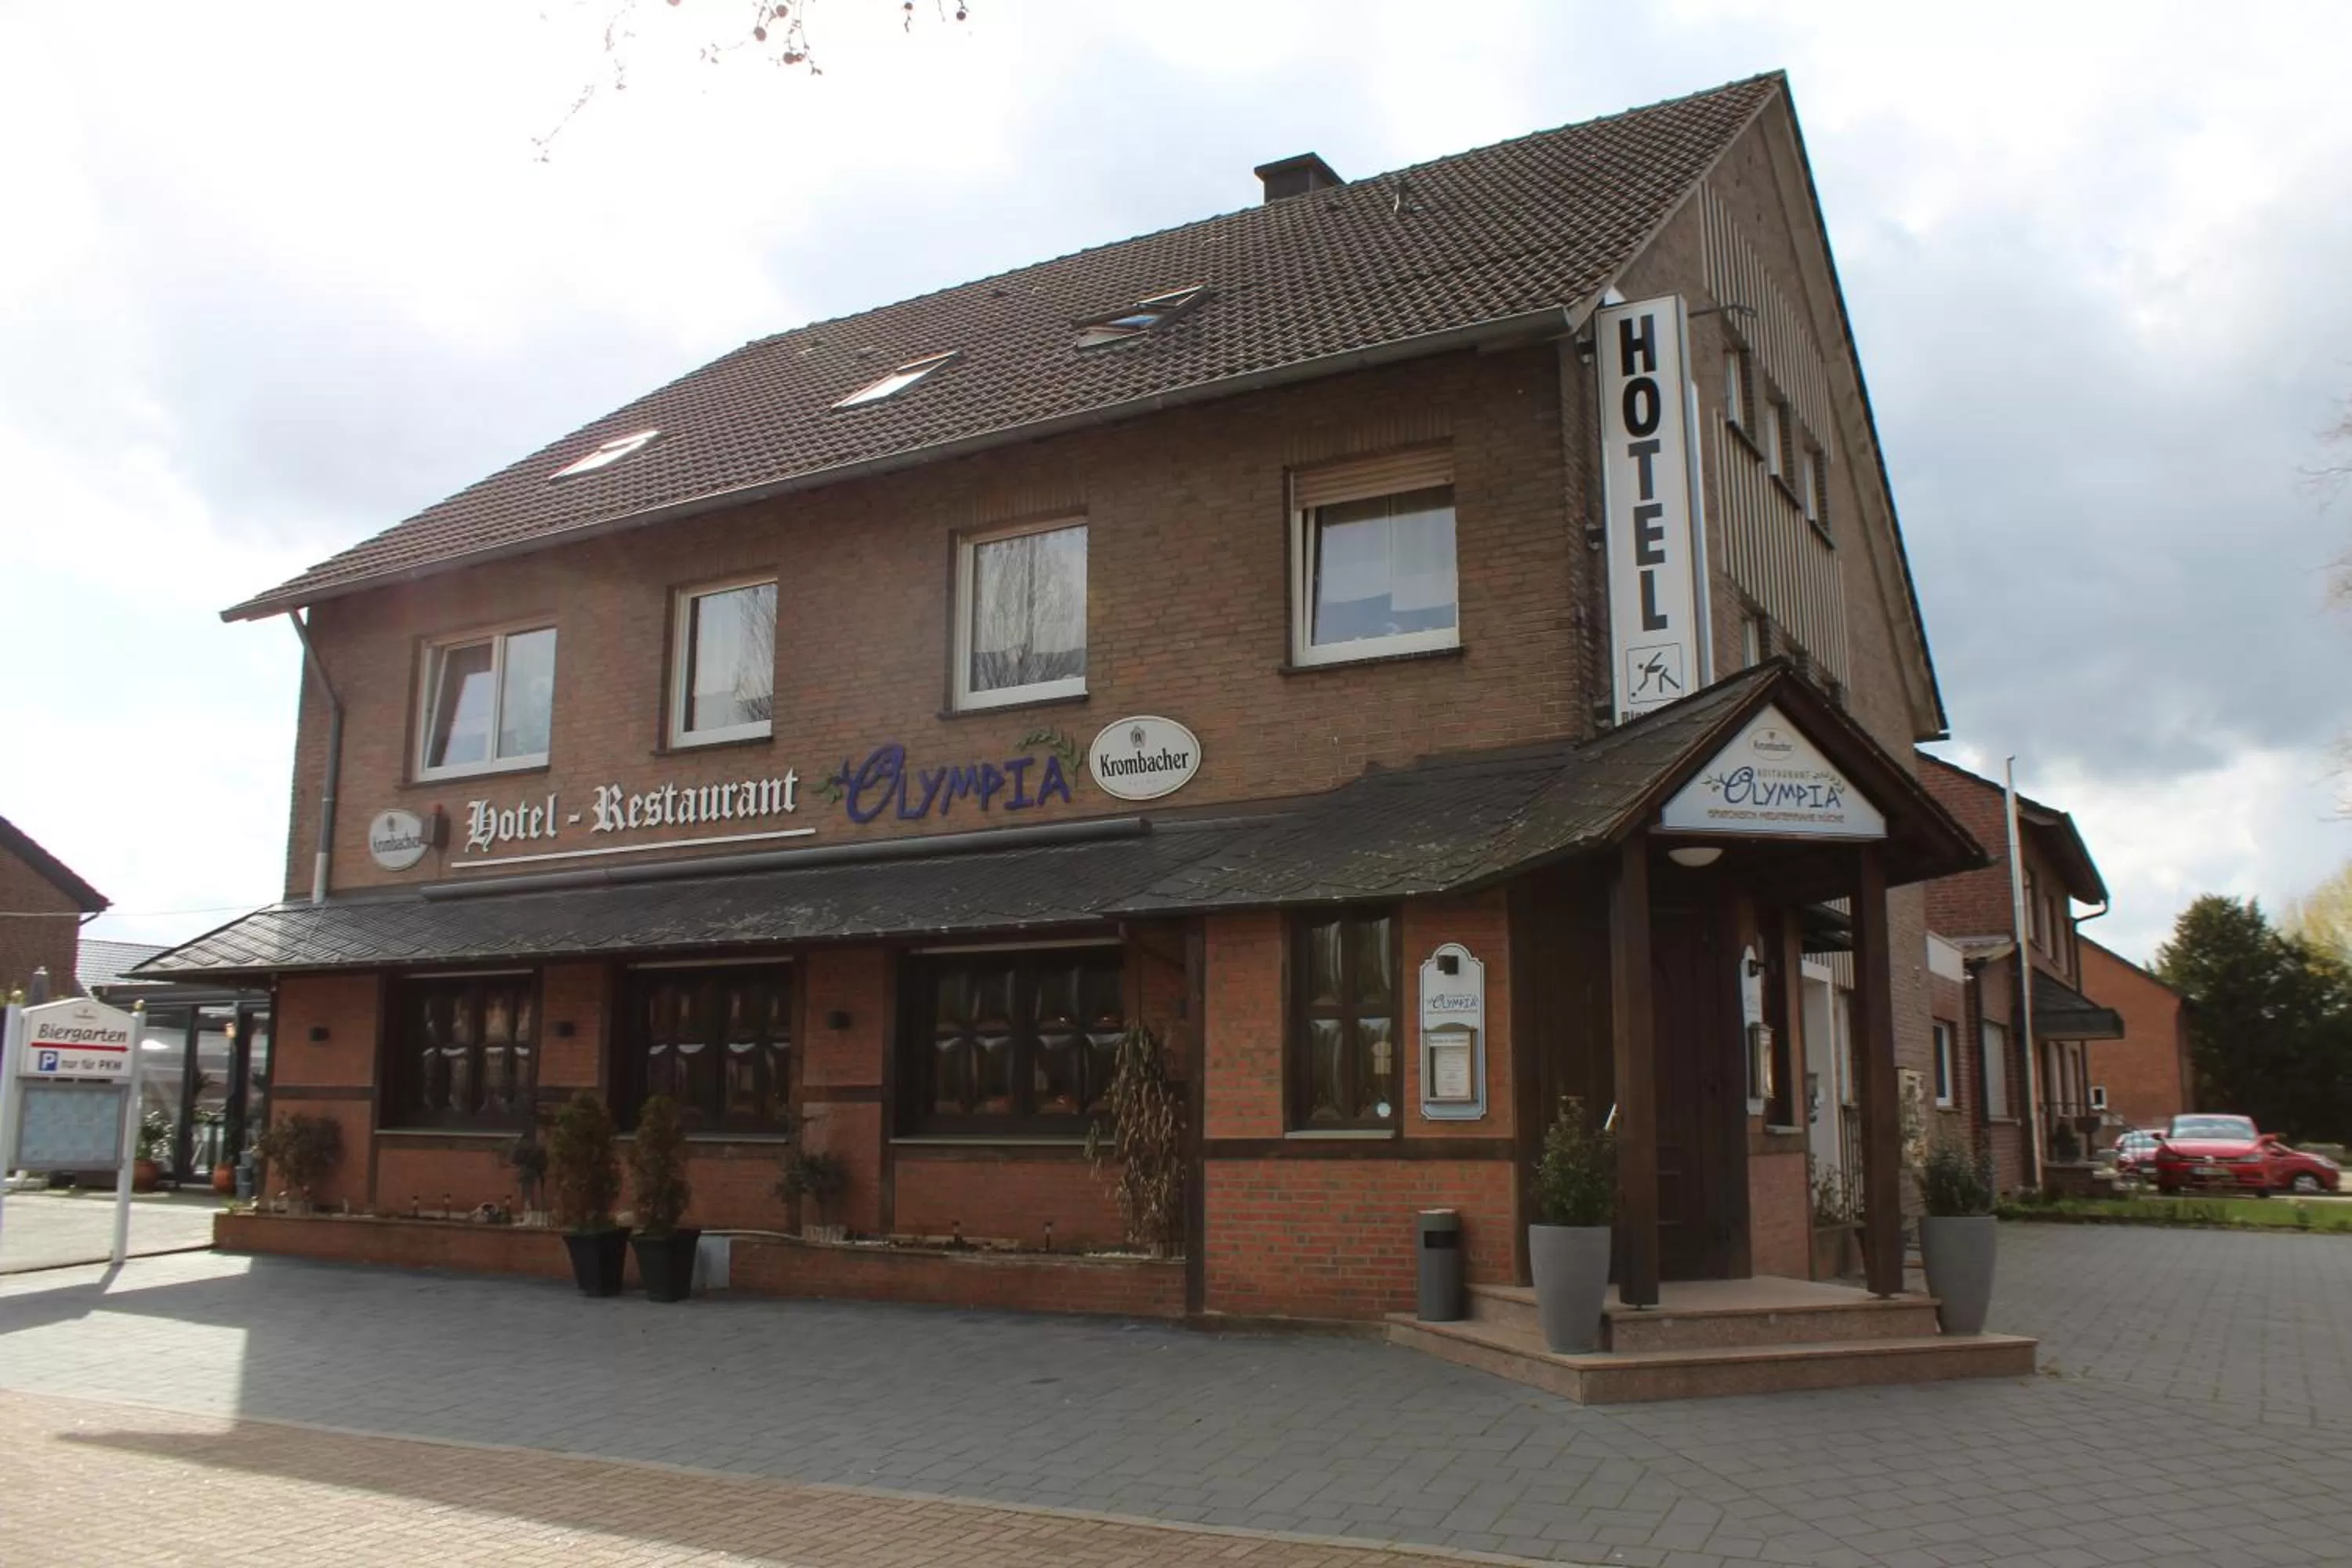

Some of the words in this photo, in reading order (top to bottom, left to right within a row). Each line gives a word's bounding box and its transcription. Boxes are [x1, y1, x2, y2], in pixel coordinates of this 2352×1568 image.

[1618, 314, 1668, 632] HOTEL
[839, 742, 1071, 823] OLYMPIA
[1100, 746, 1189, 777] Krombacher
[1722, 766, 1842, 808] OLYMPIA
[464, 793, 557, 853] Hotel
[590, 769, 798, 833] Restaurant
[38, 1023, 127, 1043] Biergarten
